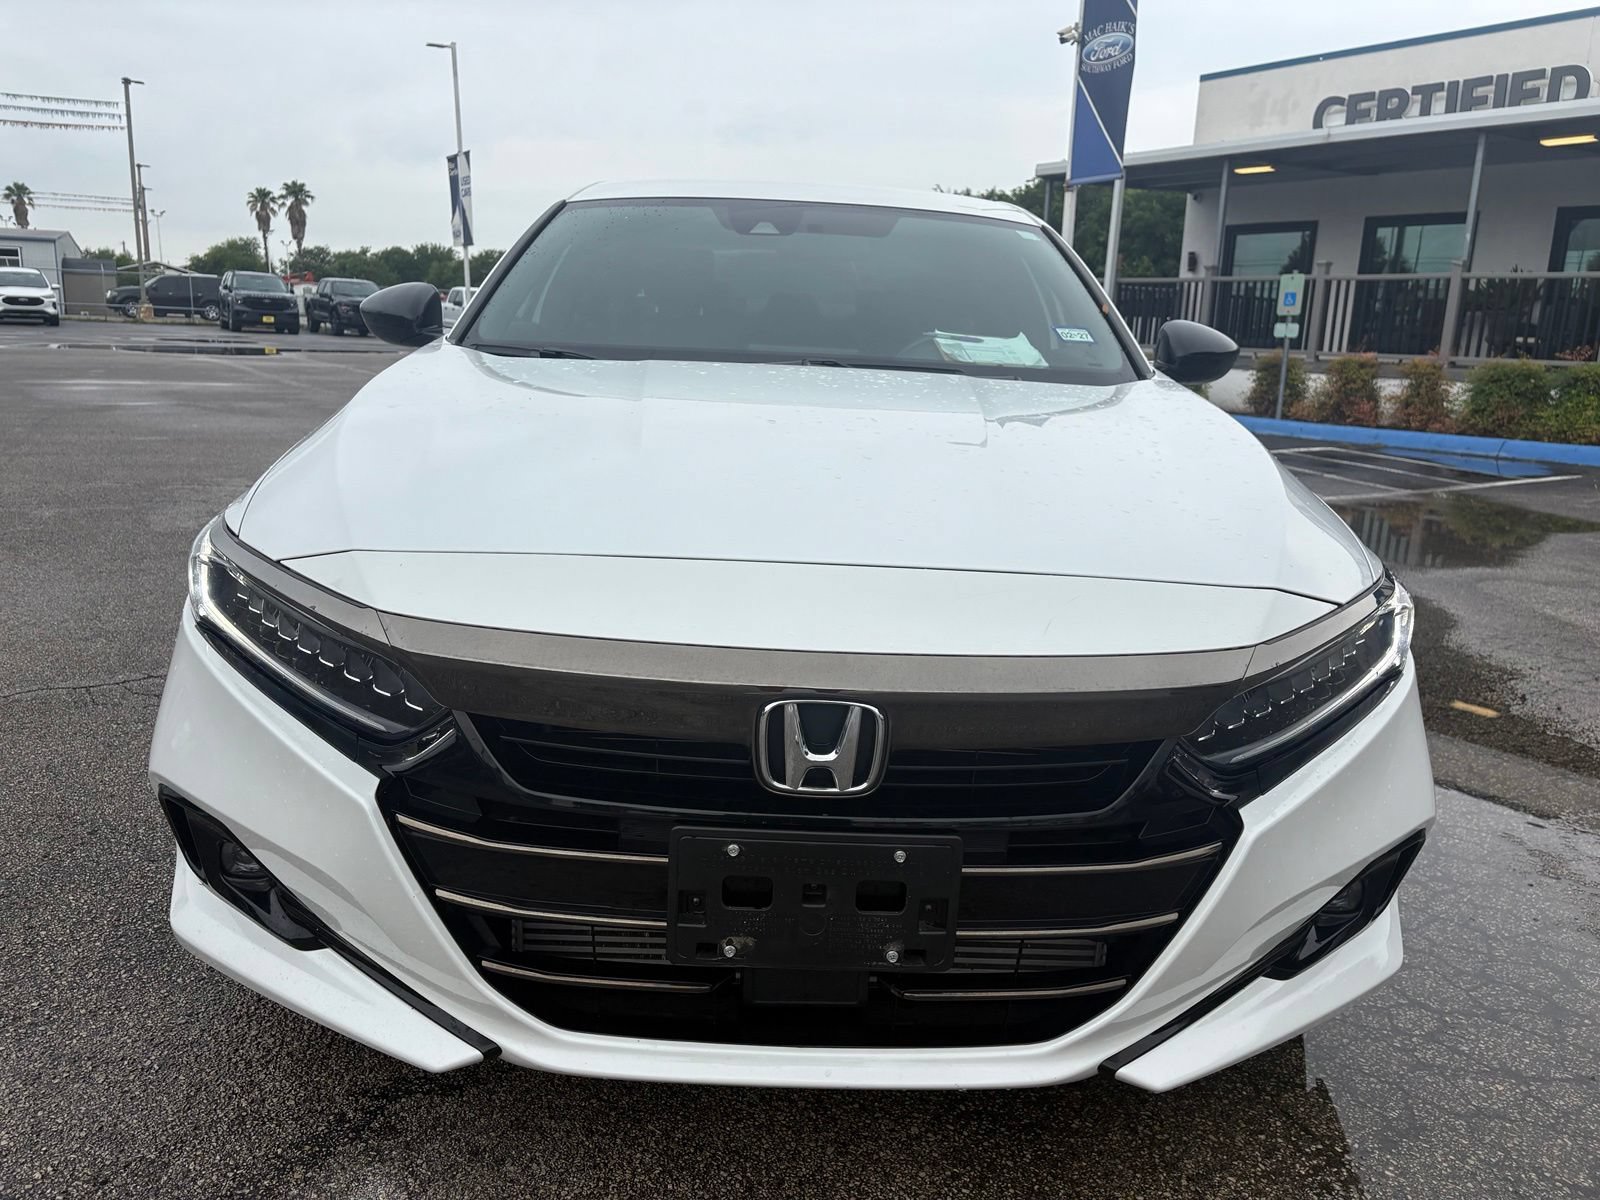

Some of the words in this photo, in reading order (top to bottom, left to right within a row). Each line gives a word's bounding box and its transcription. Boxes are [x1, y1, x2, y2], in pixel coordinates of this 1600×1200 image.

[1084, 25, 1104, 43] MAC
[1105, 21, 1135, 34] HAIK'S
[1090, 38, 1123, 61] Ford
[1113, 53, 1134, 69] FORD
[1312, 64, 1593, 130] CERTIFIED
